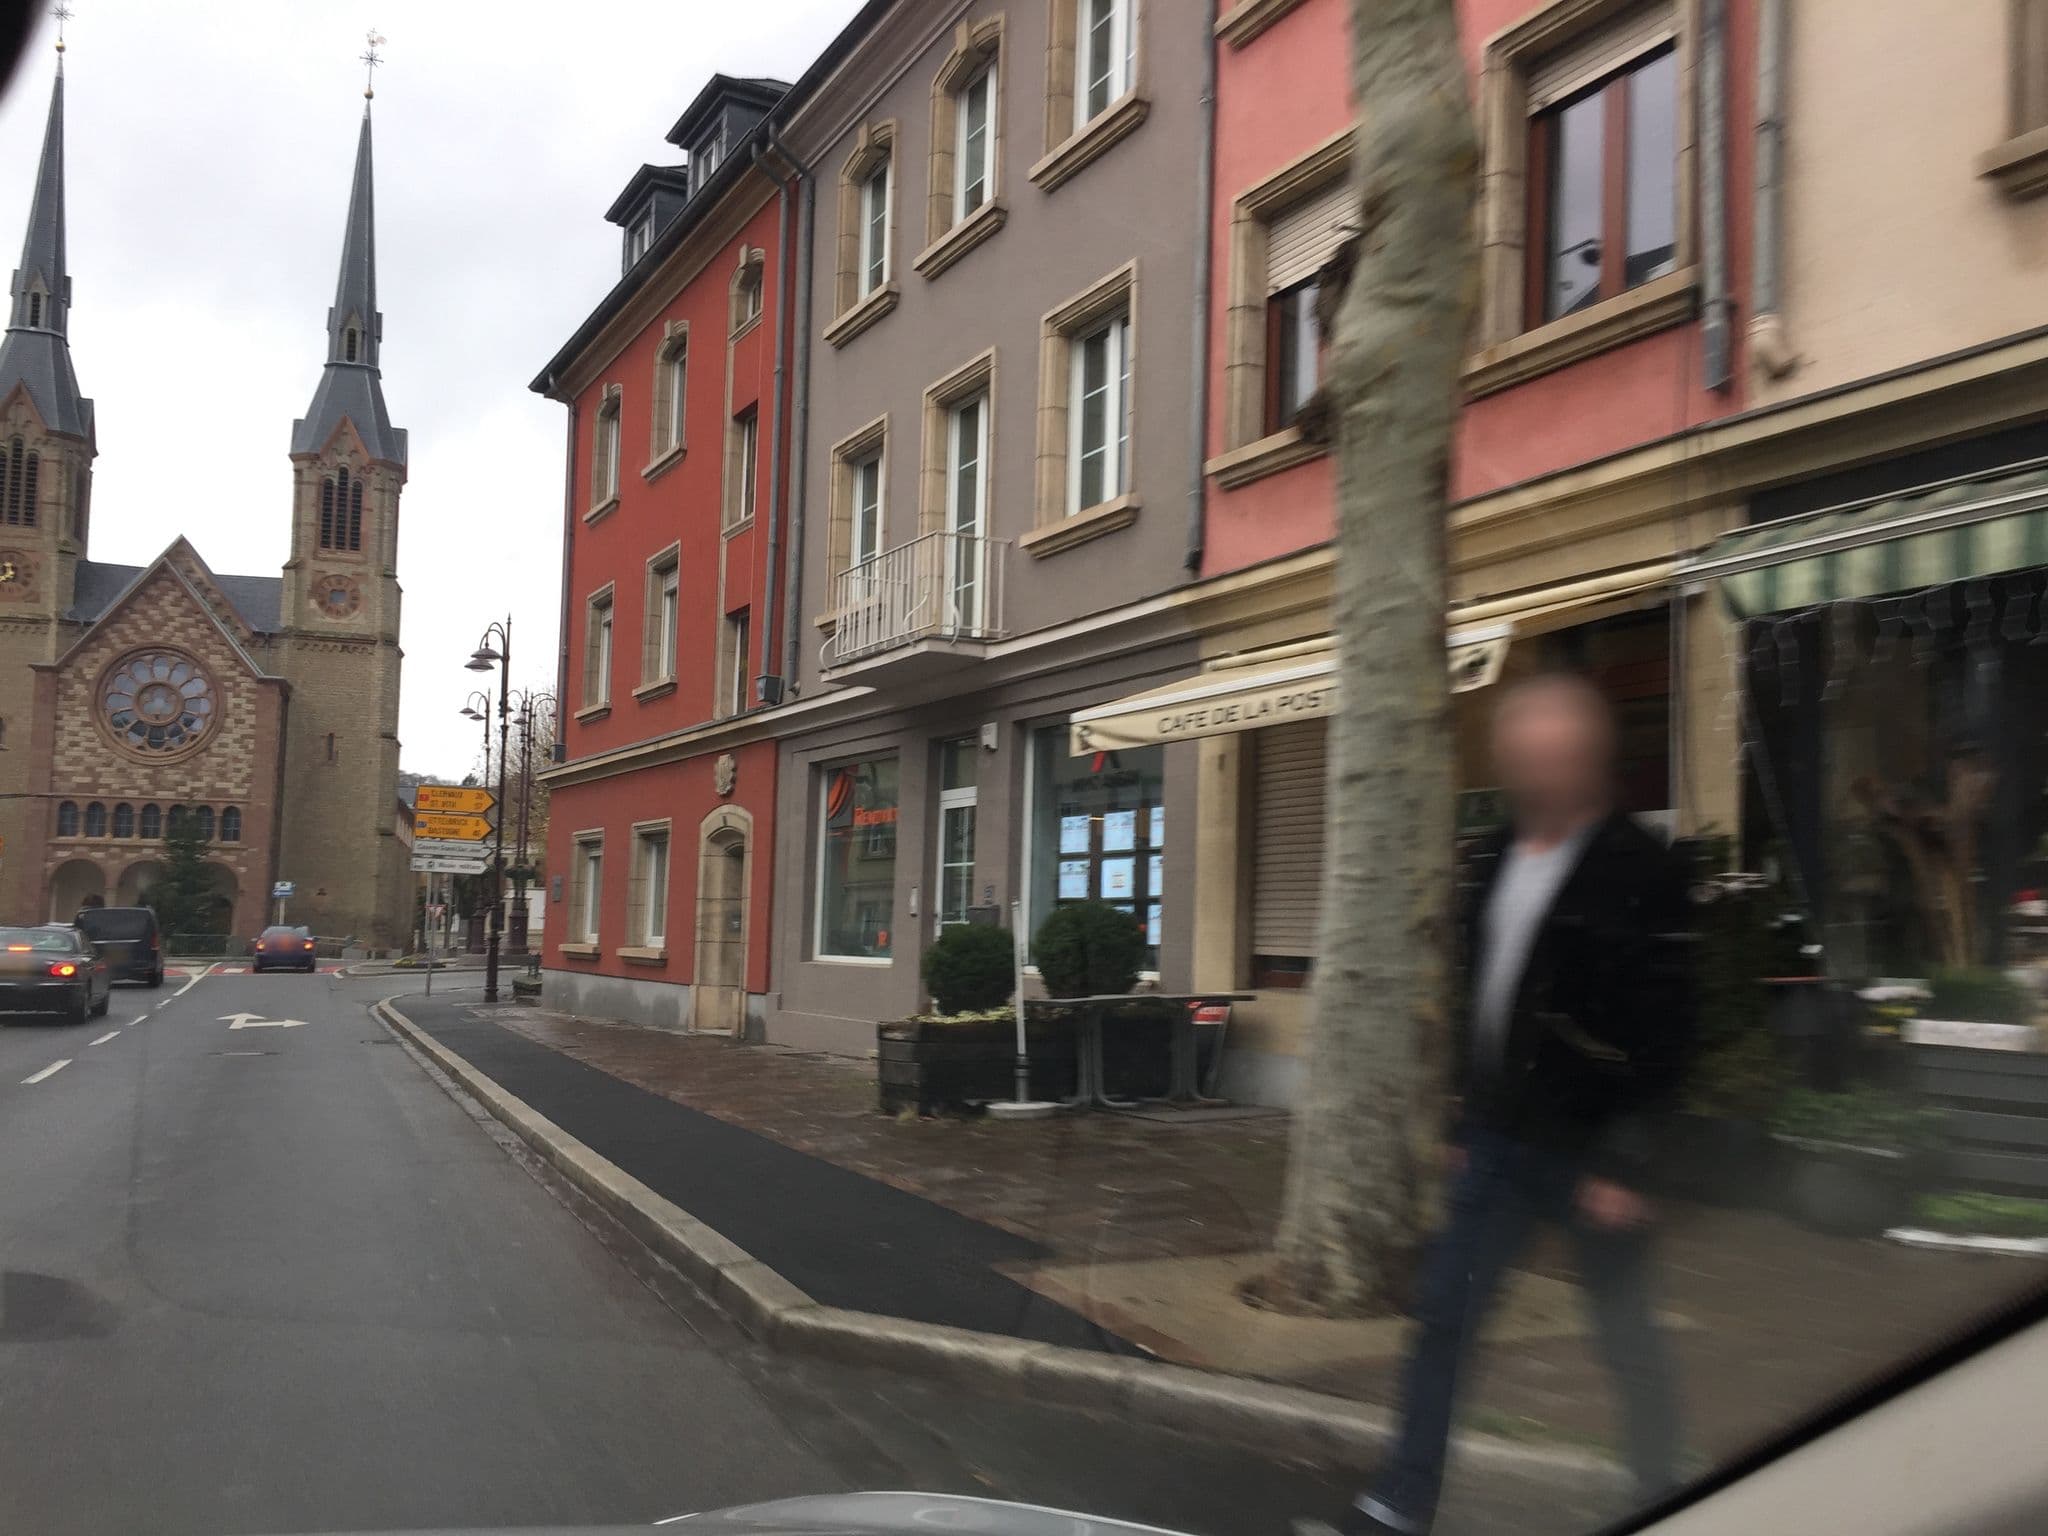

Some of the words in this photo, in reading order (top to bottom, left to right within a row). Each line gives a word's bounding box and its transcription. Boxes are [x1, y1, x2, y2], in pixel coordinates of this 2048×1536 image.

[1158, 710, 1208, 735] CAFE
[1210, 705, 1238, 725] DE
[1242, 699, 1271, 721] LA
[1275, 687, 1336, 712] POST
